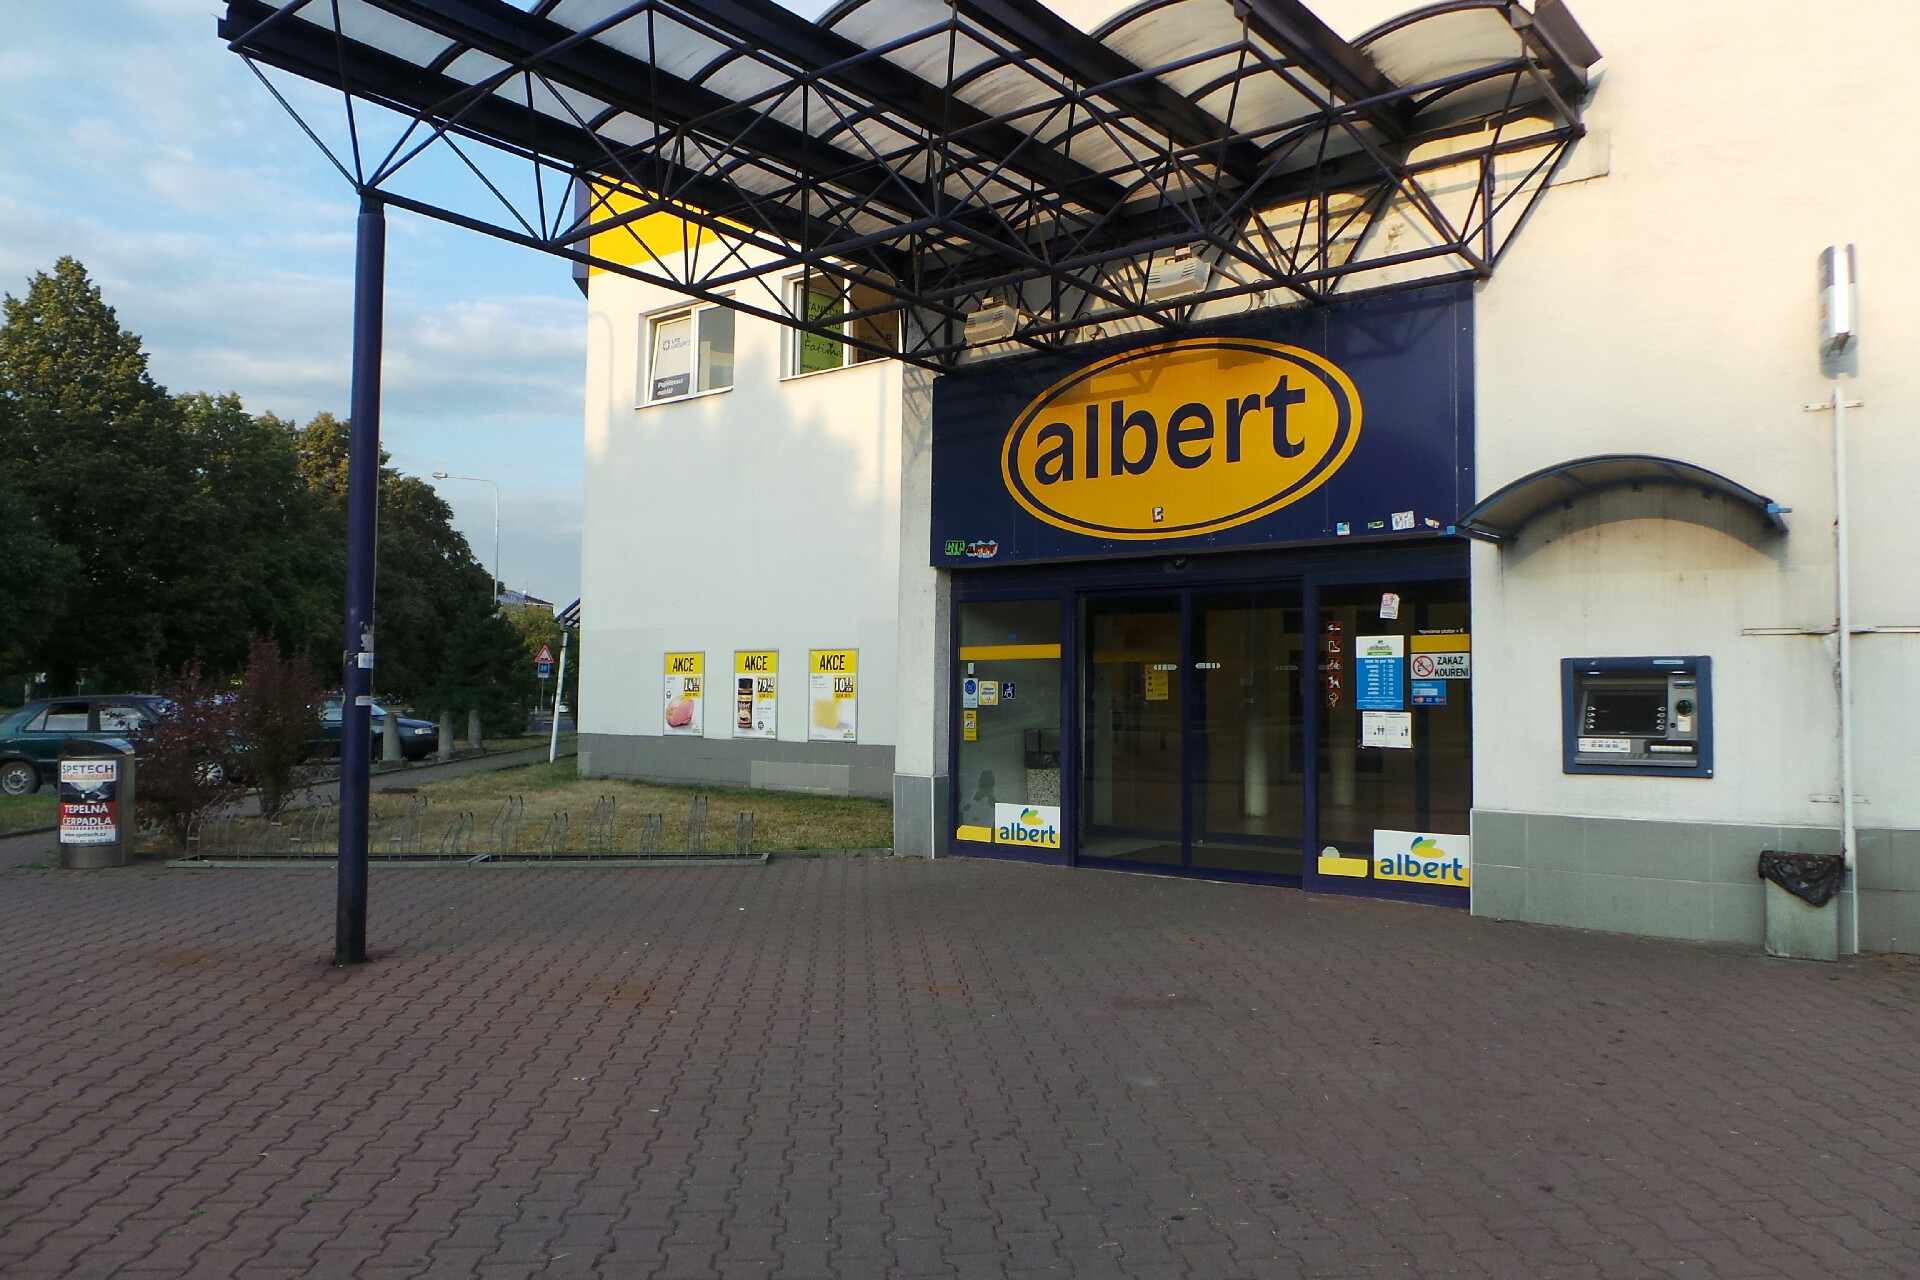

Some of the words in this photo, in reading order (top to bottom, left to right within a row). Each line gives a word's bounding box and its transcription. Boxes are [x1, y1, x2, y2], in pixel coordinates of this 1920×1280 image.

[1034, 374, 1306, 486] albert
[673, 658, 694, 672] AKCE
[744, 656, 768, 671] AKCE
[819, 655, 846, 671] AKCE
[1437, 655, 1464, 665] ZÁKAZ
[1434, 666, 1469, 677] KOUŘENÍ
[62, 764, 114, 774] SPETECH
[64, 803, 109, 814] TEPELNÁ
[62, 815, 112, 826] ČERPADLA
[1000, 822, 1056, 845] albert
[1380, 853, 1464, 881] albert
